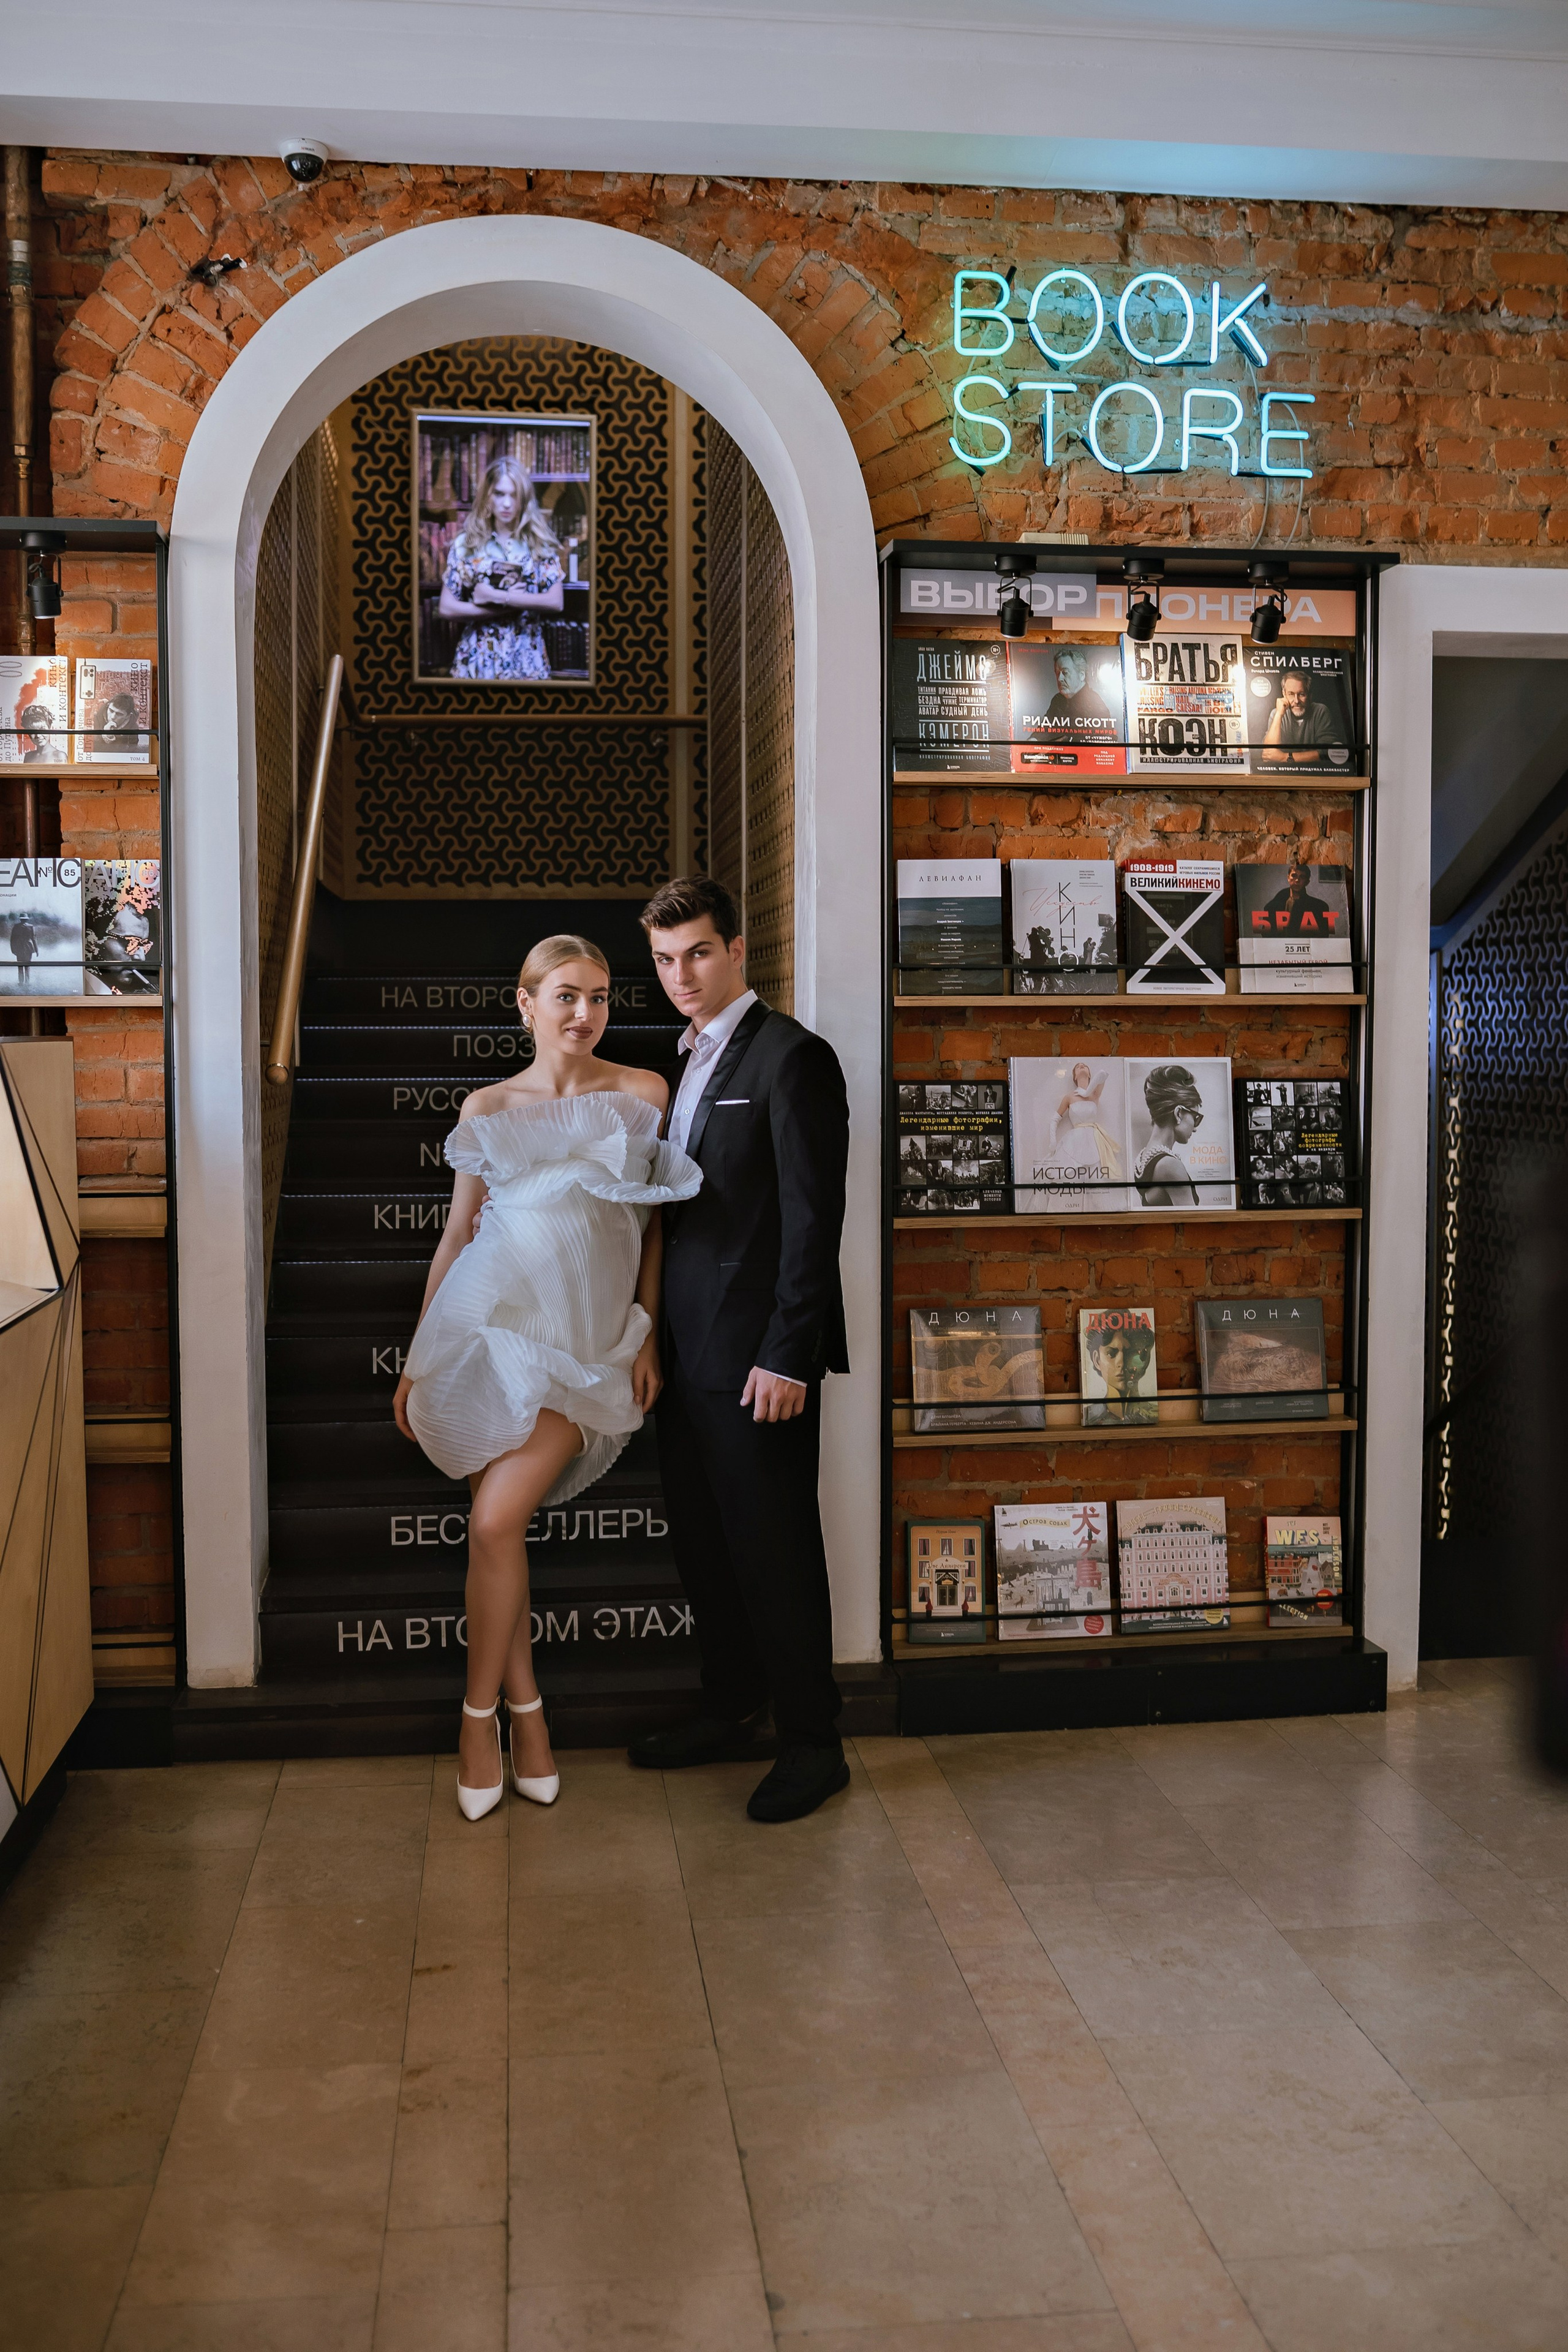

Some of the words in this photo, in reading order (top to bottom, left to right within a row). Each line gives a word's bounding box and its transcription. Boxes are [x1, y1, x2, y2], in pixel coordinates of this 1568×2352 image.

[954, 270, 1268, 366] BOOK
[949, 375, 1316, 478] STORE
[1096, 592, 1322, 623] ПОНЕА
[1134, 642, 1238, 682] БРАТЬЯ
[1250, 656, 1342, 668] СПИЛБЕРГ
[918, 696, 941, 705] БЕЗДНА
[938, 687, 969, 696] ПРАВДИВАЯ
[971, 687, 987, 696] ЛОЖЬ
[919, 707, 939, 715] АВАТАР
[941, 706, 967, 717] СУДНЫЙ
[971, 707, 988, 717] ДЕНЬ
[1022, 715, 1070, 728] РИДЛИ
[1075, 717, 1117, 728] СКОТТ
[4, 717, 12, 749] Путна
[919, 723, 990, 748] КЭМЕРОН
[1138, 718, 1227, 756] КОЭН
[78, 752, 83, 761] от
[88, 859, 160, 888] АНС
[1251, 911, 1340, 935] БРАТ
[381, 987, 418, 1008] НА
[427, 986, 518, 1008] ВТОРО
[453, 1035, 535, 1058] ПОЭЗ
[1193, 1146, 1223, 1155] МОДА
[1190, 1156, 1196, 1165] В
[1198, 1156, 1227, 1165] КИНО
[1033, 1167, 1110, 1180] ИСТОРИЯ
[1033, 1182, 1085, 1196] МОДЫ
[929, 1310, 1022, 1325] ДЮНА
[1086, 1313, 1152, 1333] ДЮНА
[1223, 1308, 1300, 1321] ДЮНА
[1275, 1529, 1320, 1545] WES
[338, 1619, 393, 1653] НА
[405, 1610, 579, 1649] ВТООМ
[593, 1605, 695, 1640] ЭТАЖ
